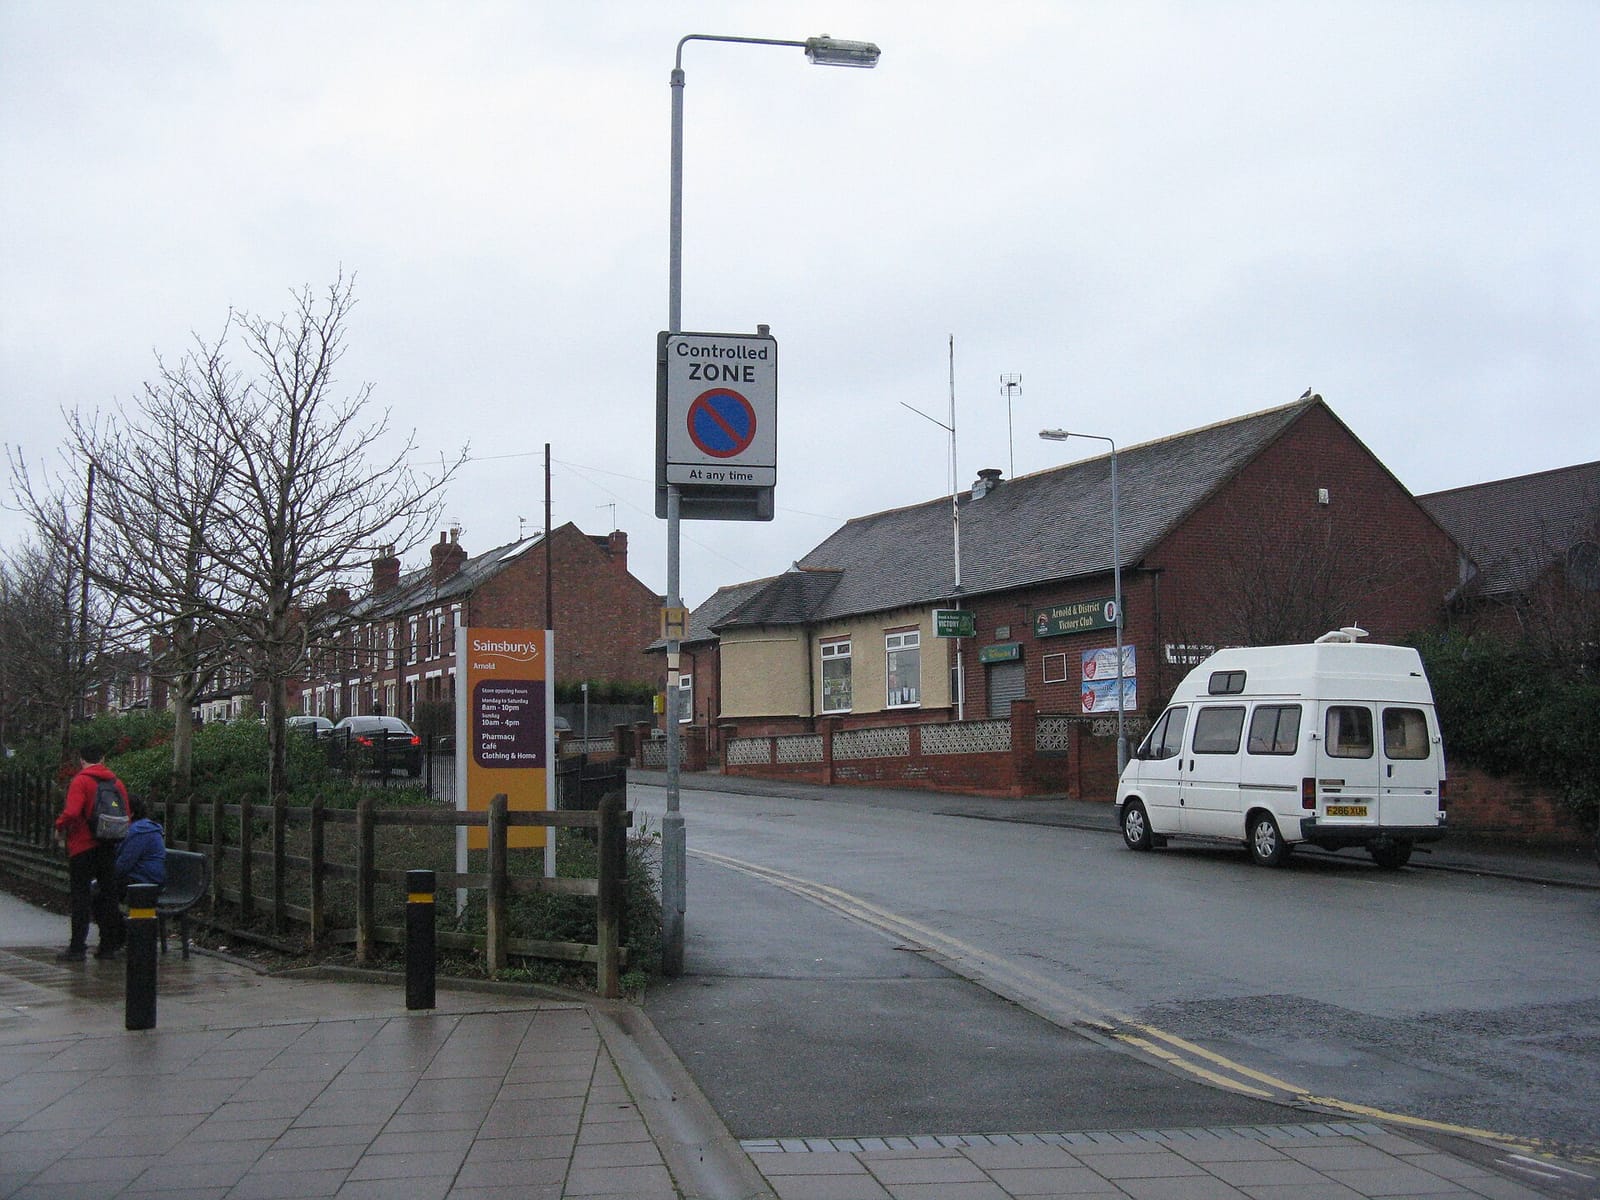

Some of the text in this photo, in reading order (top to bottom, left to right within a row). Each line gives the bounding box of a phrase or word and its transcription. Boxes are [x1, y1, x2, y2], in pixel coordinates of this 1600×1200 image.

[677, 342, 768, 360] Controlled
[689, 363, 755, 383] ZONE
[689, 469, 753, 481] At any time
[1051, 602, 1100, 619] Arnold & District
[1058, 620, 1079, 630] Victory
[1080, 616, 1093, 627] Club
[473, 640, 536, 655] Sainsbury's
[473, 662, 496, 670] Arnold
[502, 704, 520, 712] 10pm
[505, 719, 520, 727] 4pm
[482, 733, 515, 742] Pharmacy
[482, 742, 497, 750] Café
[482, 752, 510, 761] Clothing
